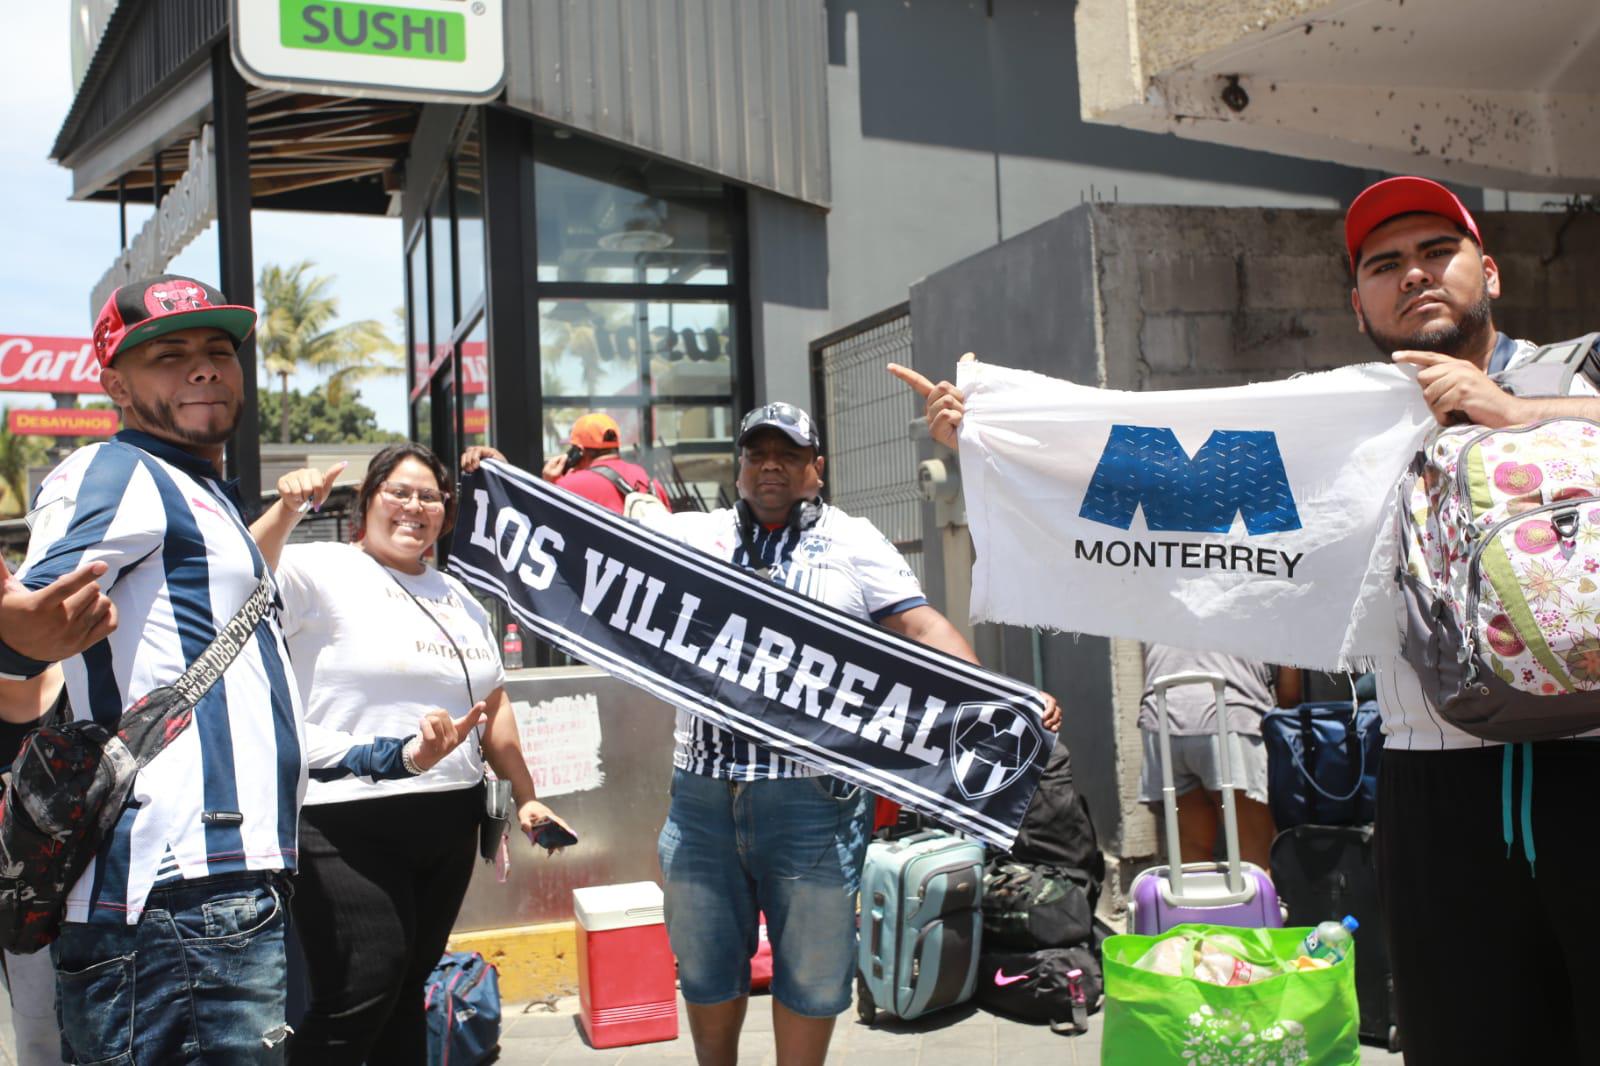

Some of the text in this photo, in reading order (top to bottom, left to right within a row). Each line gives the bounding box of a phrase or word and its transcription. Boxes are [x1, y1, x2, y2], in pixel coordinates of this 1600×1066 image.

[302, 4, 447, 55] SUSHI
[16, 413, 112, 430] DESAYUNOS
[1075, 539, 1303, 578] MONTERREY
[470, 488, 947, 766] LOS VILLARREAL
